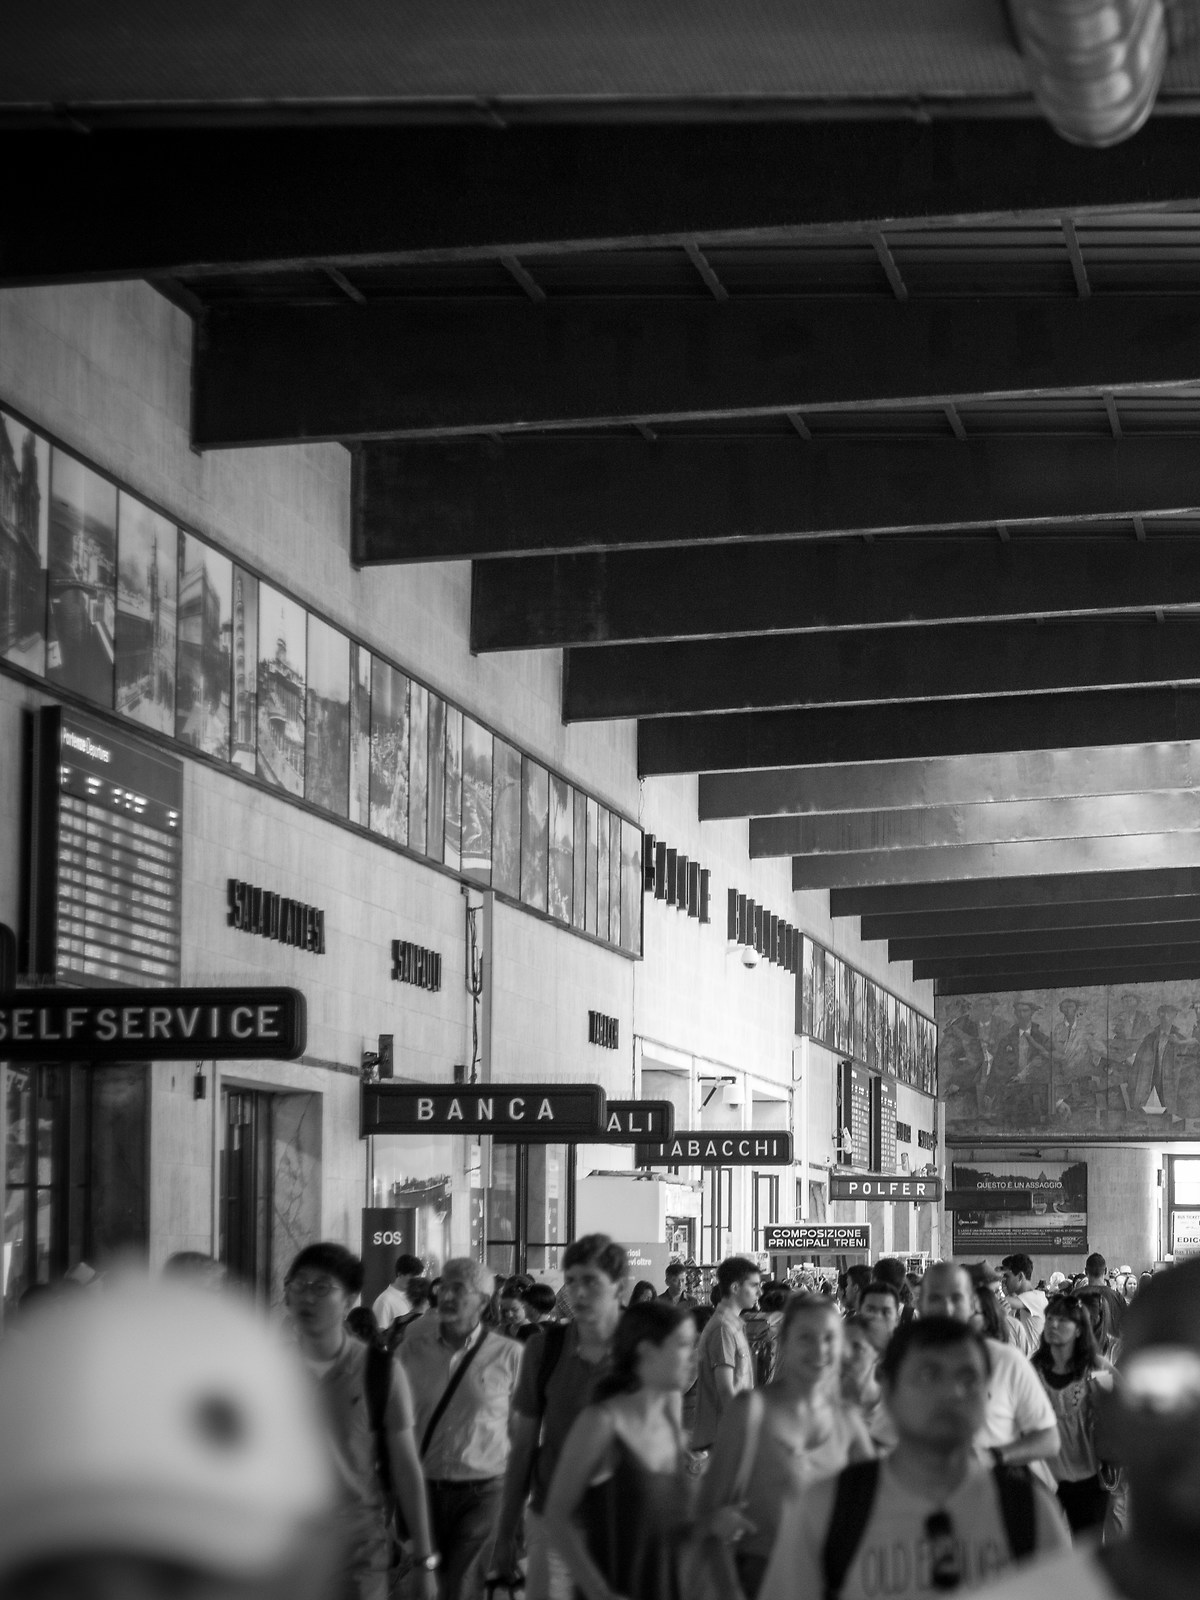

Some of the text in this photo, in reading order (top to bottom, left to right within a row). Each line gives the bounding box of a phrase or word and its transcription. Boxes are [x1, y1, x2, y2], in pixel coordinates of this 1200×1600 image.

[0, 1008, 88, 1040] ELF
[417, 1098, 554, 1121] BANCA
[607, 1112, 652, 1133] ALI
[849, 1182, 926, 1196] POLFER
[976, 1181, 1007, 1190] QUESTO
[1014, 1181, 1025, 1189] UN
[373, 1231, 402, 1245] SOS
[772, 1229, 862, 1239] COMPOSIZIONE
[768, 1238, 867, 1247] PRINCIPALI TRENI
